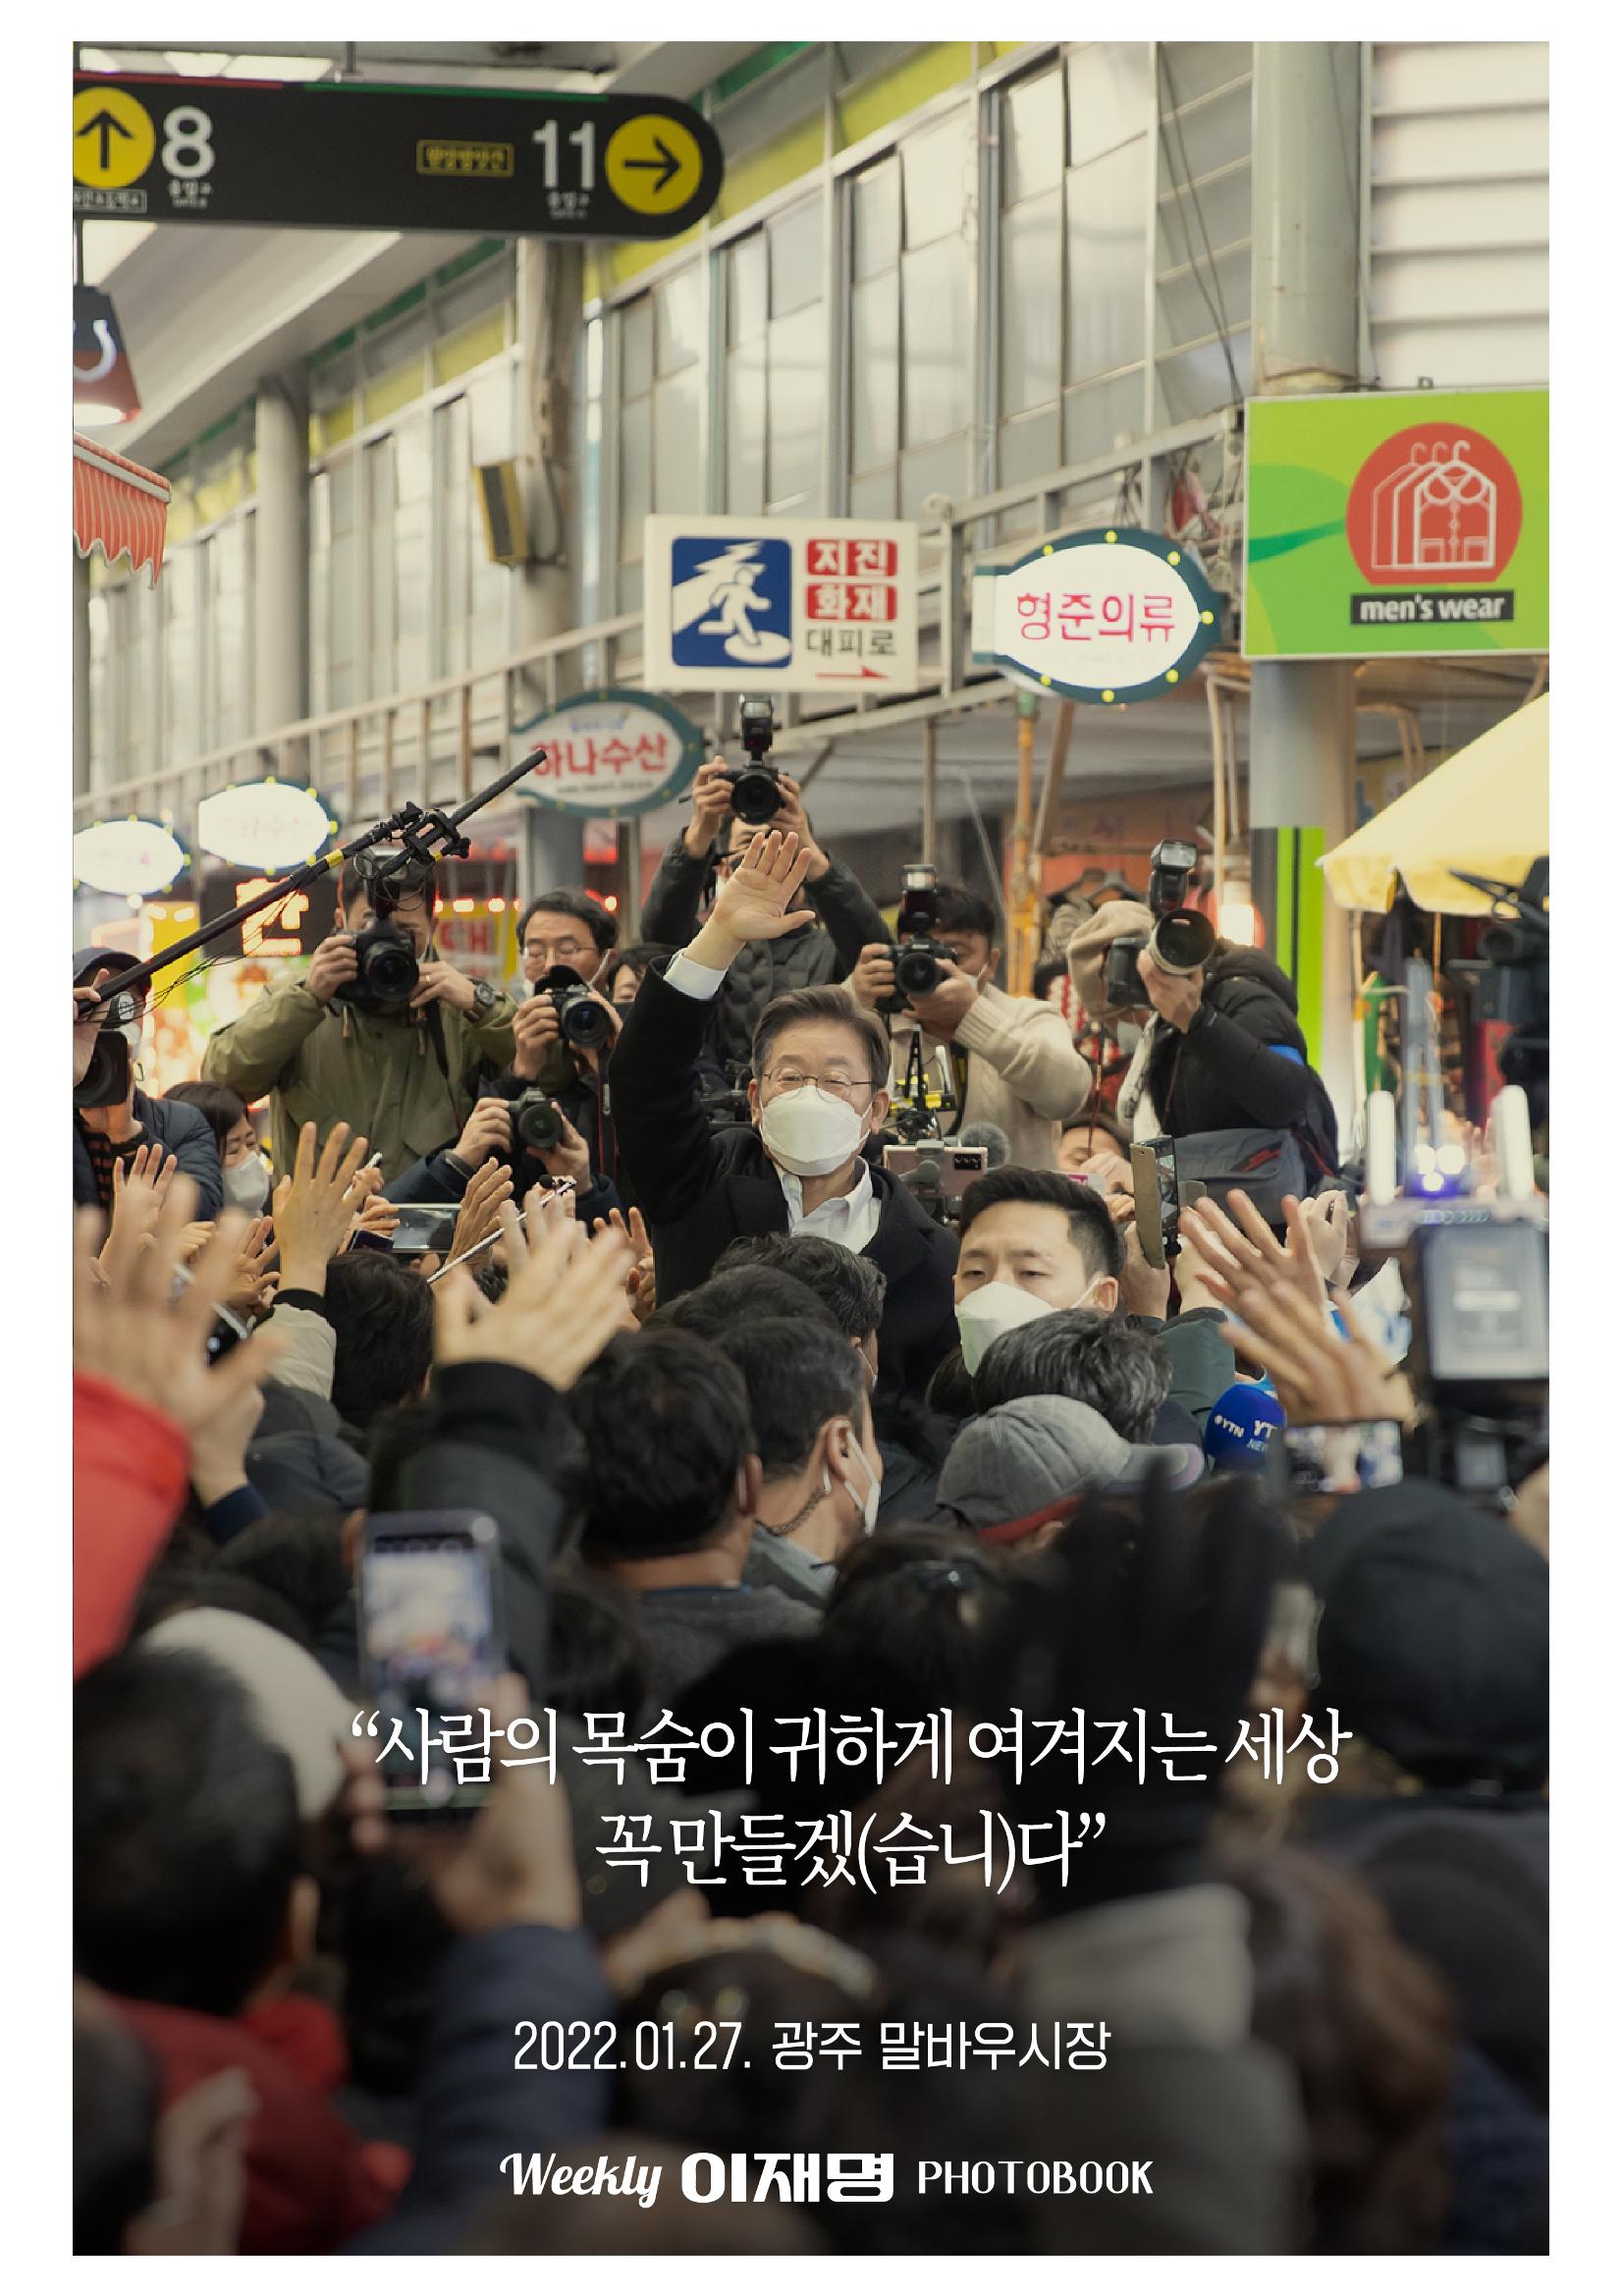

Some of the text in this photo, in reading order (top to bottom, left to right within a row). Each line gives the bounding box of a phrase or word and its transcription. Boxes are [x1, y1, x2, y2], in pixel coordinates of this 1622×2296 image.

[161, 105, 215, 179] 8
[532, 119, 596, 190] 11
[813, 540, 889, 574] 지진
[811, 582, 889, 620] 화재
[1016, 591, 1176, 643] 형준의류
[1360, 593, 1505, 622] men's wear
[805, 628, 896, 657] 대피로
[530, 733, 668, 779] 하나수산
[1253, 1419, 1278, 1439] YT
